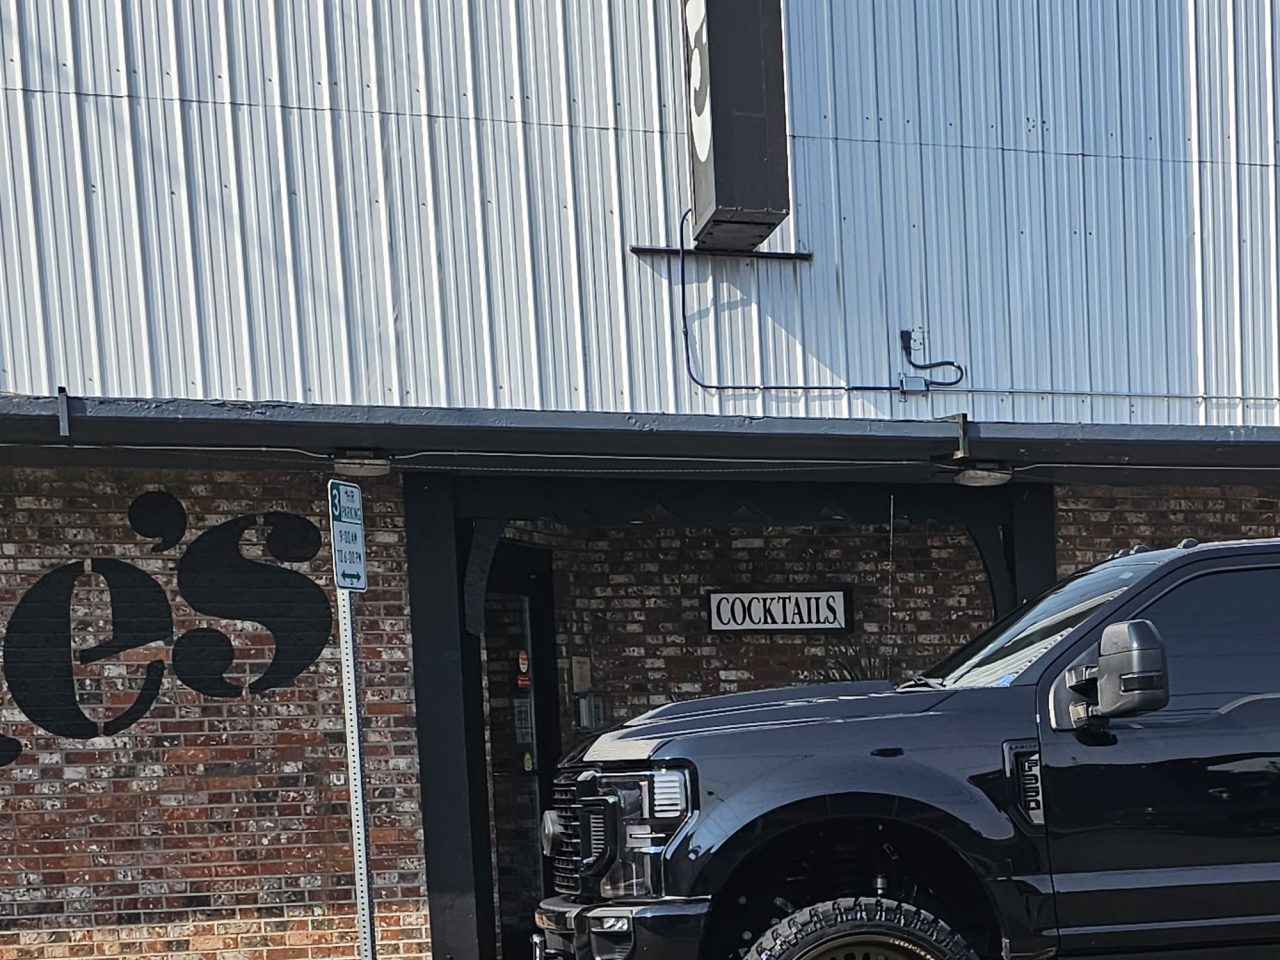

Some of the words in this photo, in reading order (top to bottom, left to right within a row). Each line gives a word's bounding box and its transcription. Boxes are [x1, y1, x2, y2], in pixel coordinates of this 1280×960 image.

[332, 489, 340, 516] 3
[716, 595, 837, 626] COCKTAILS
[0, 491, 332, 767] e's
